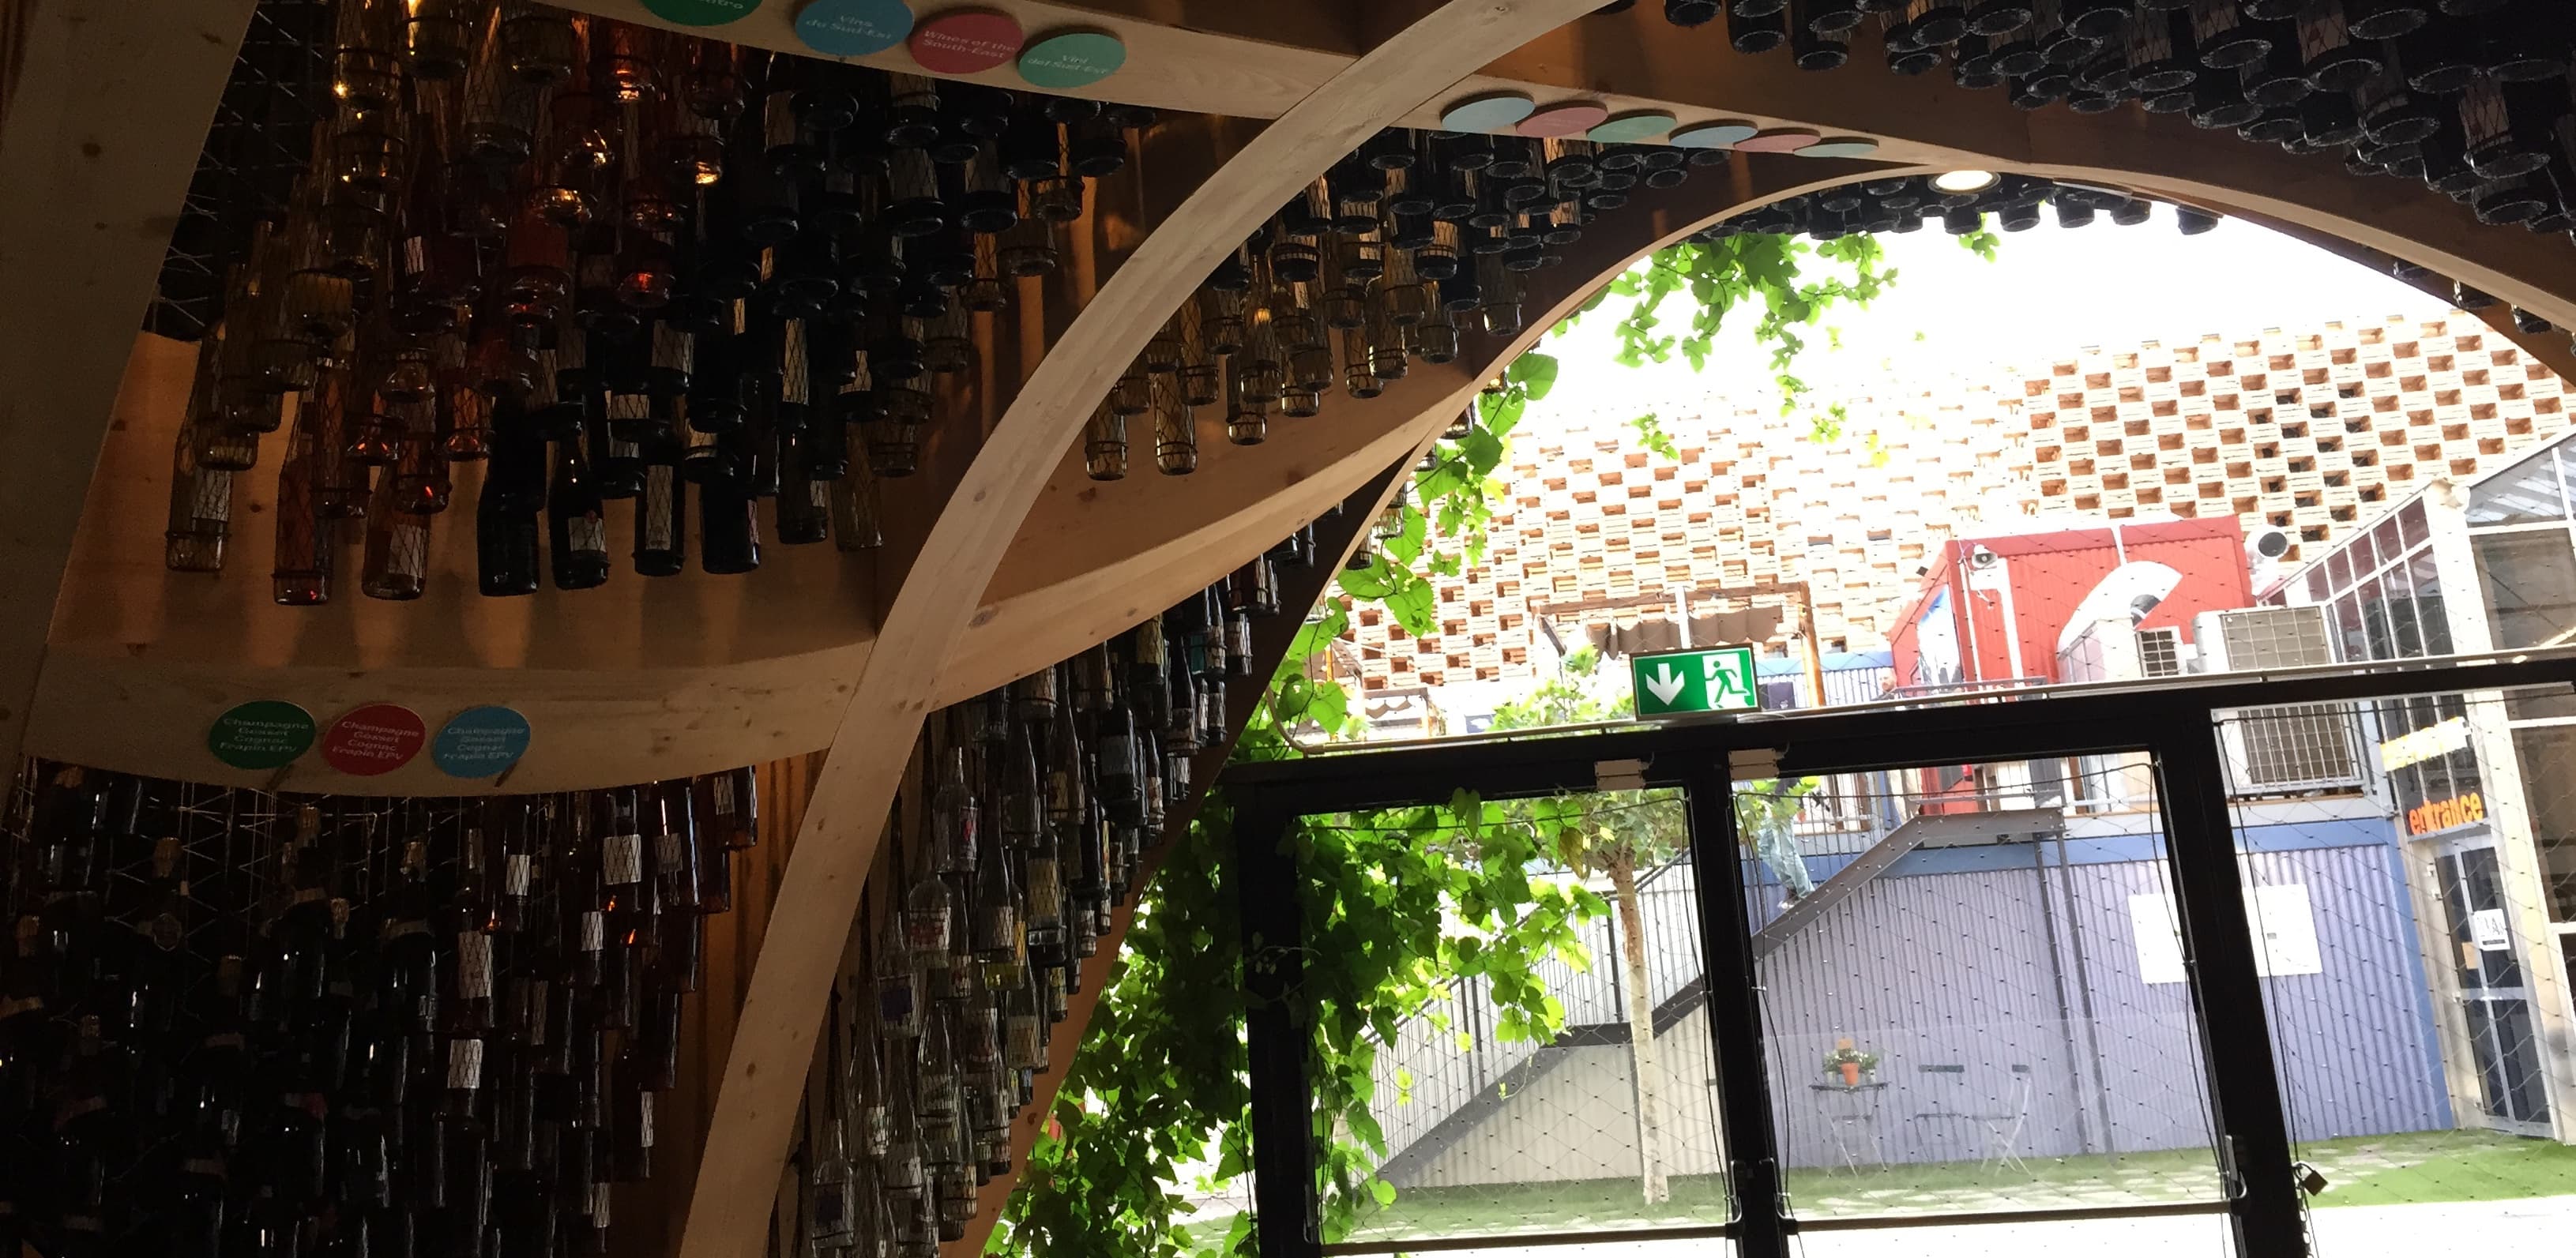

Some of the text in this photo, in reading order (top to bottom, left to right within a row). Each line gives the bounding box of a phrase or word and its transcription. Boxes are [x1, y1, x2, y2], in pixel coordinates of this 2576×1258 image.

[923, 30, 968, 43] Wines
[992, 43, 1016, 52] the
[923, 39, 1005, 58] South-East
[224, 719, 309, 730] Champagne
[341, 721, 419, 737] Champagne
[447, 727, 525, 736] Champagne
[234, 735, 288, 744] Cognac
[354, 731, 399, 743] Gosset
[348, 738, 397, 751] Cognac
[332, 745, 404, 760] Frapin EPV
[2409, 792, 2483, 836] entrance
